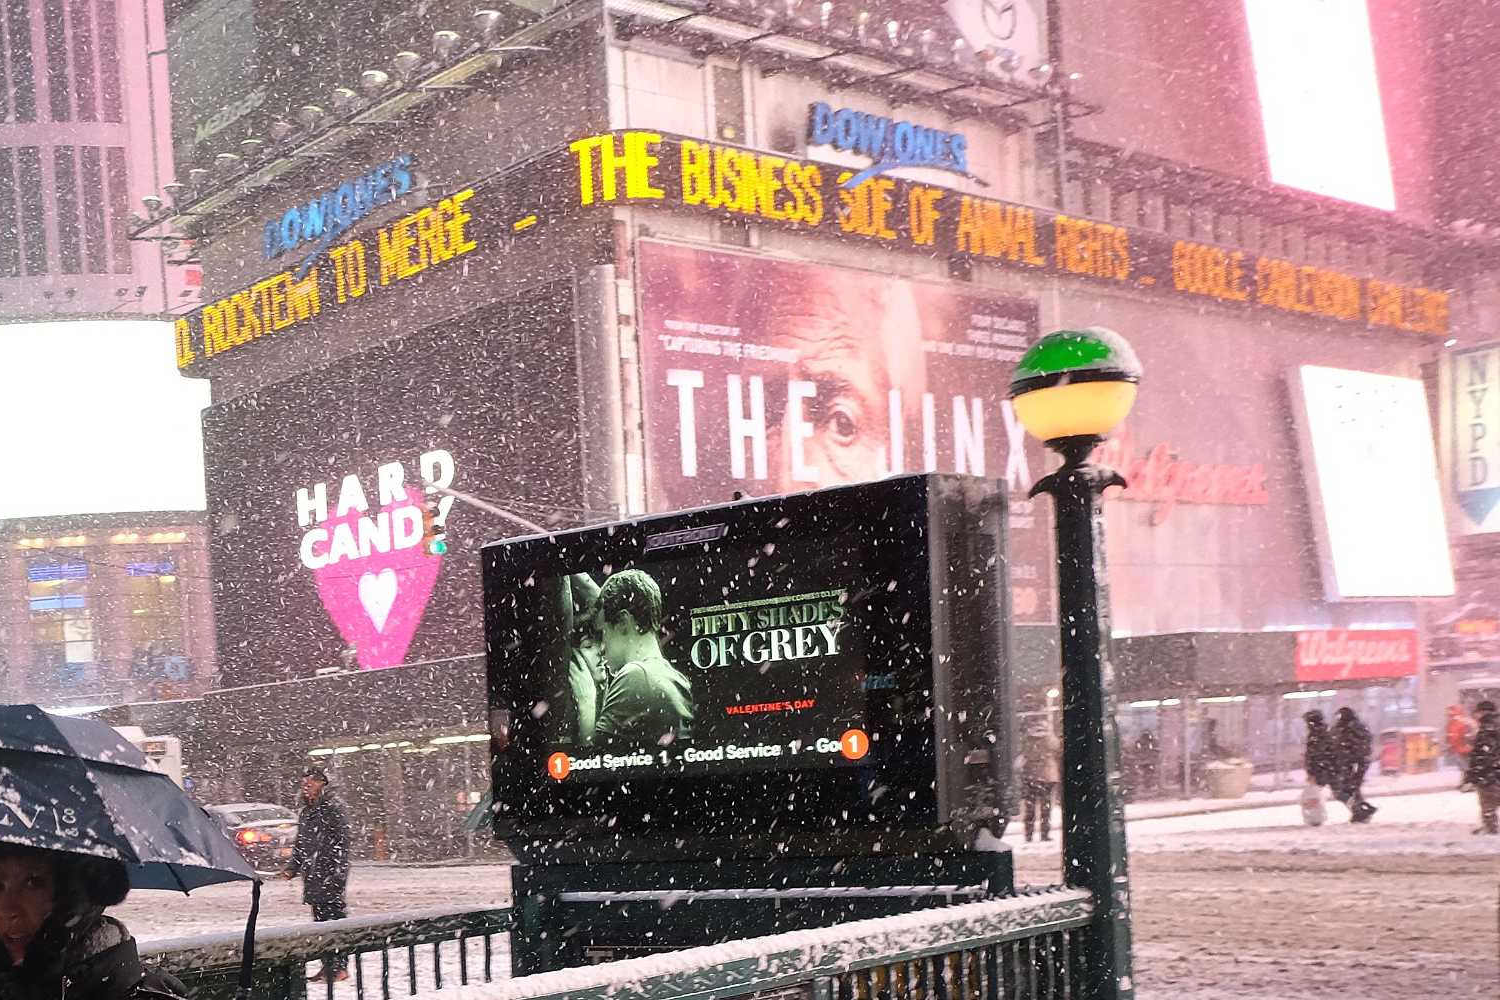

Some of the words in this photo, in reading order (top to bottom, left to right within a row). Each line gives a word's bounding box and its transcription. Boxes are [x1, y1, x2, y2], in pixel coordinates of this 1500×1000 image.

[569, 132, 665, 206] THE
[680, 140, 824, 226] BUSINESS
[909, 187, 944, 245] OF
[329, 240, 367, 303] TO
[378, 188, 477, 286] MERGE
[667, 369, 820, 482] THE
[1467, 355, 1490, 488] NYPD
[296, 449, 454, 527] HARD
[691, 610, 750, 636] FIFTY
[756, 600, 845, 629] SHADES
[691, 633, 741, 669] OF
[743, 622, 844, 664] GREY
[1300, 631, 1411, 677] Walgreens
[725, 700, 792, 715] VALENTINE'S
[794, 698, 816, 710] DAY
[567, 756, 600, 771] Good
[603, 751, 652, 769] Service
[659, 751, 668, 764] 1
[684, 746, 723, 763] Good
[725, 743, 781, 759] Service
[788, 740, 797, 755] 1
